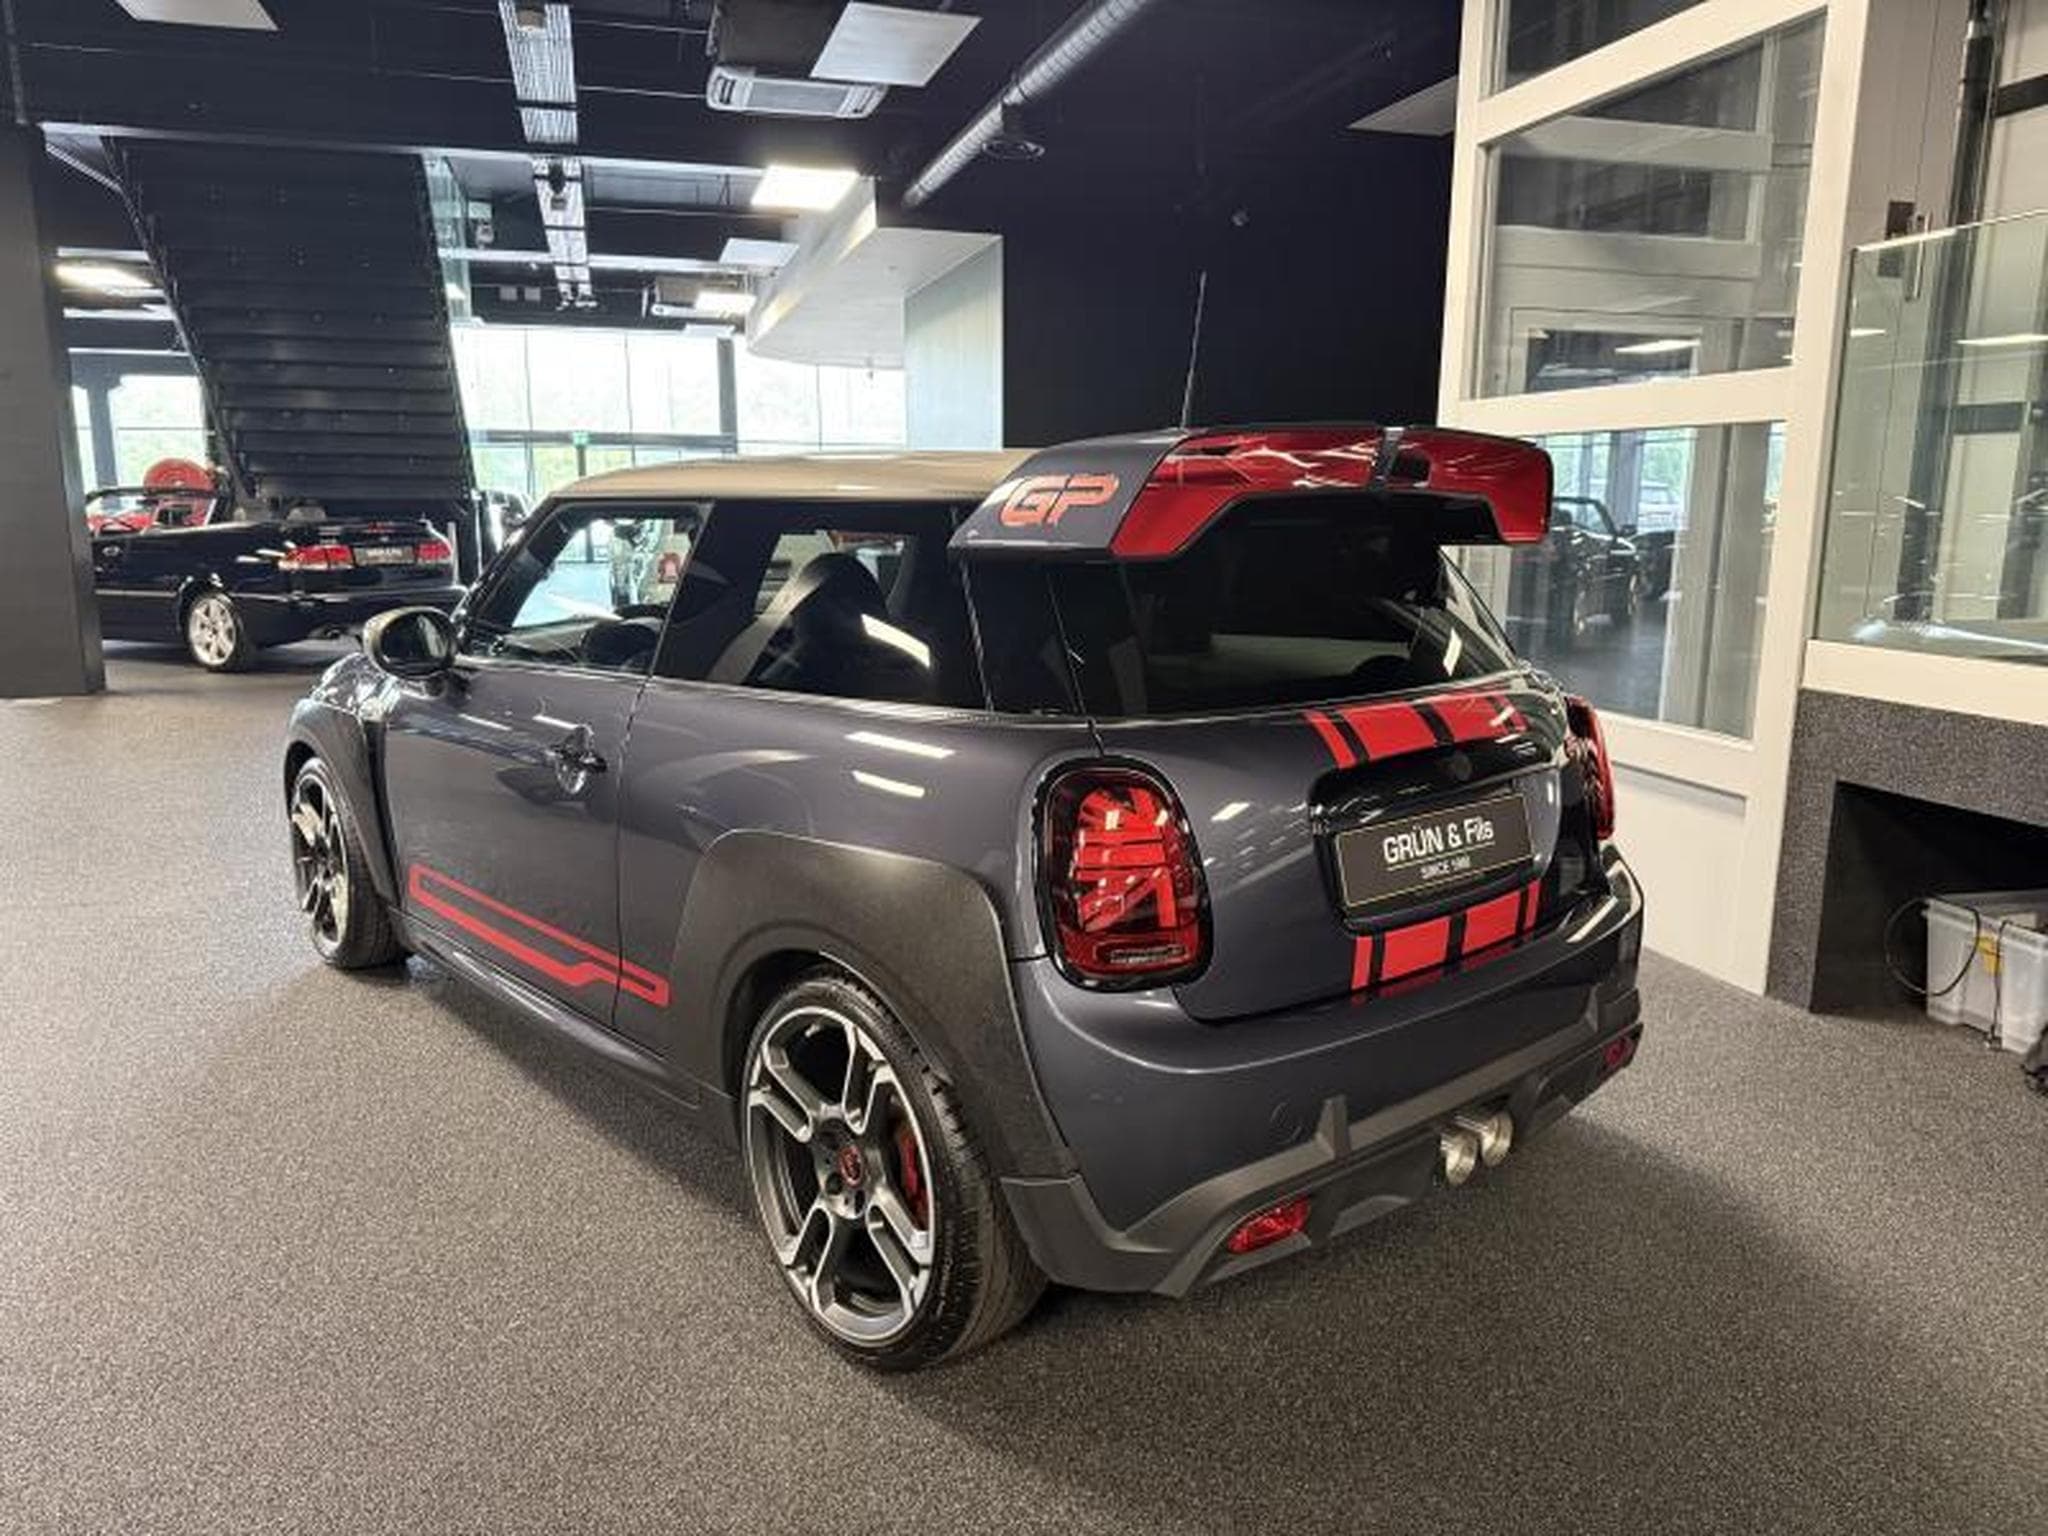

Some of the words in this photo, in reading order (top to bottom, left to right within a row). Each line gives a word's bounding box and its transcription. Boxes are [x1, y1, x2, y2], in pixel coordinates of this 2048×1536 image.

[1001, 473, 1120, 527] GP
[1383, 825, 1444, 863] GRÜN
[1447, 823, 1463, 848] &
